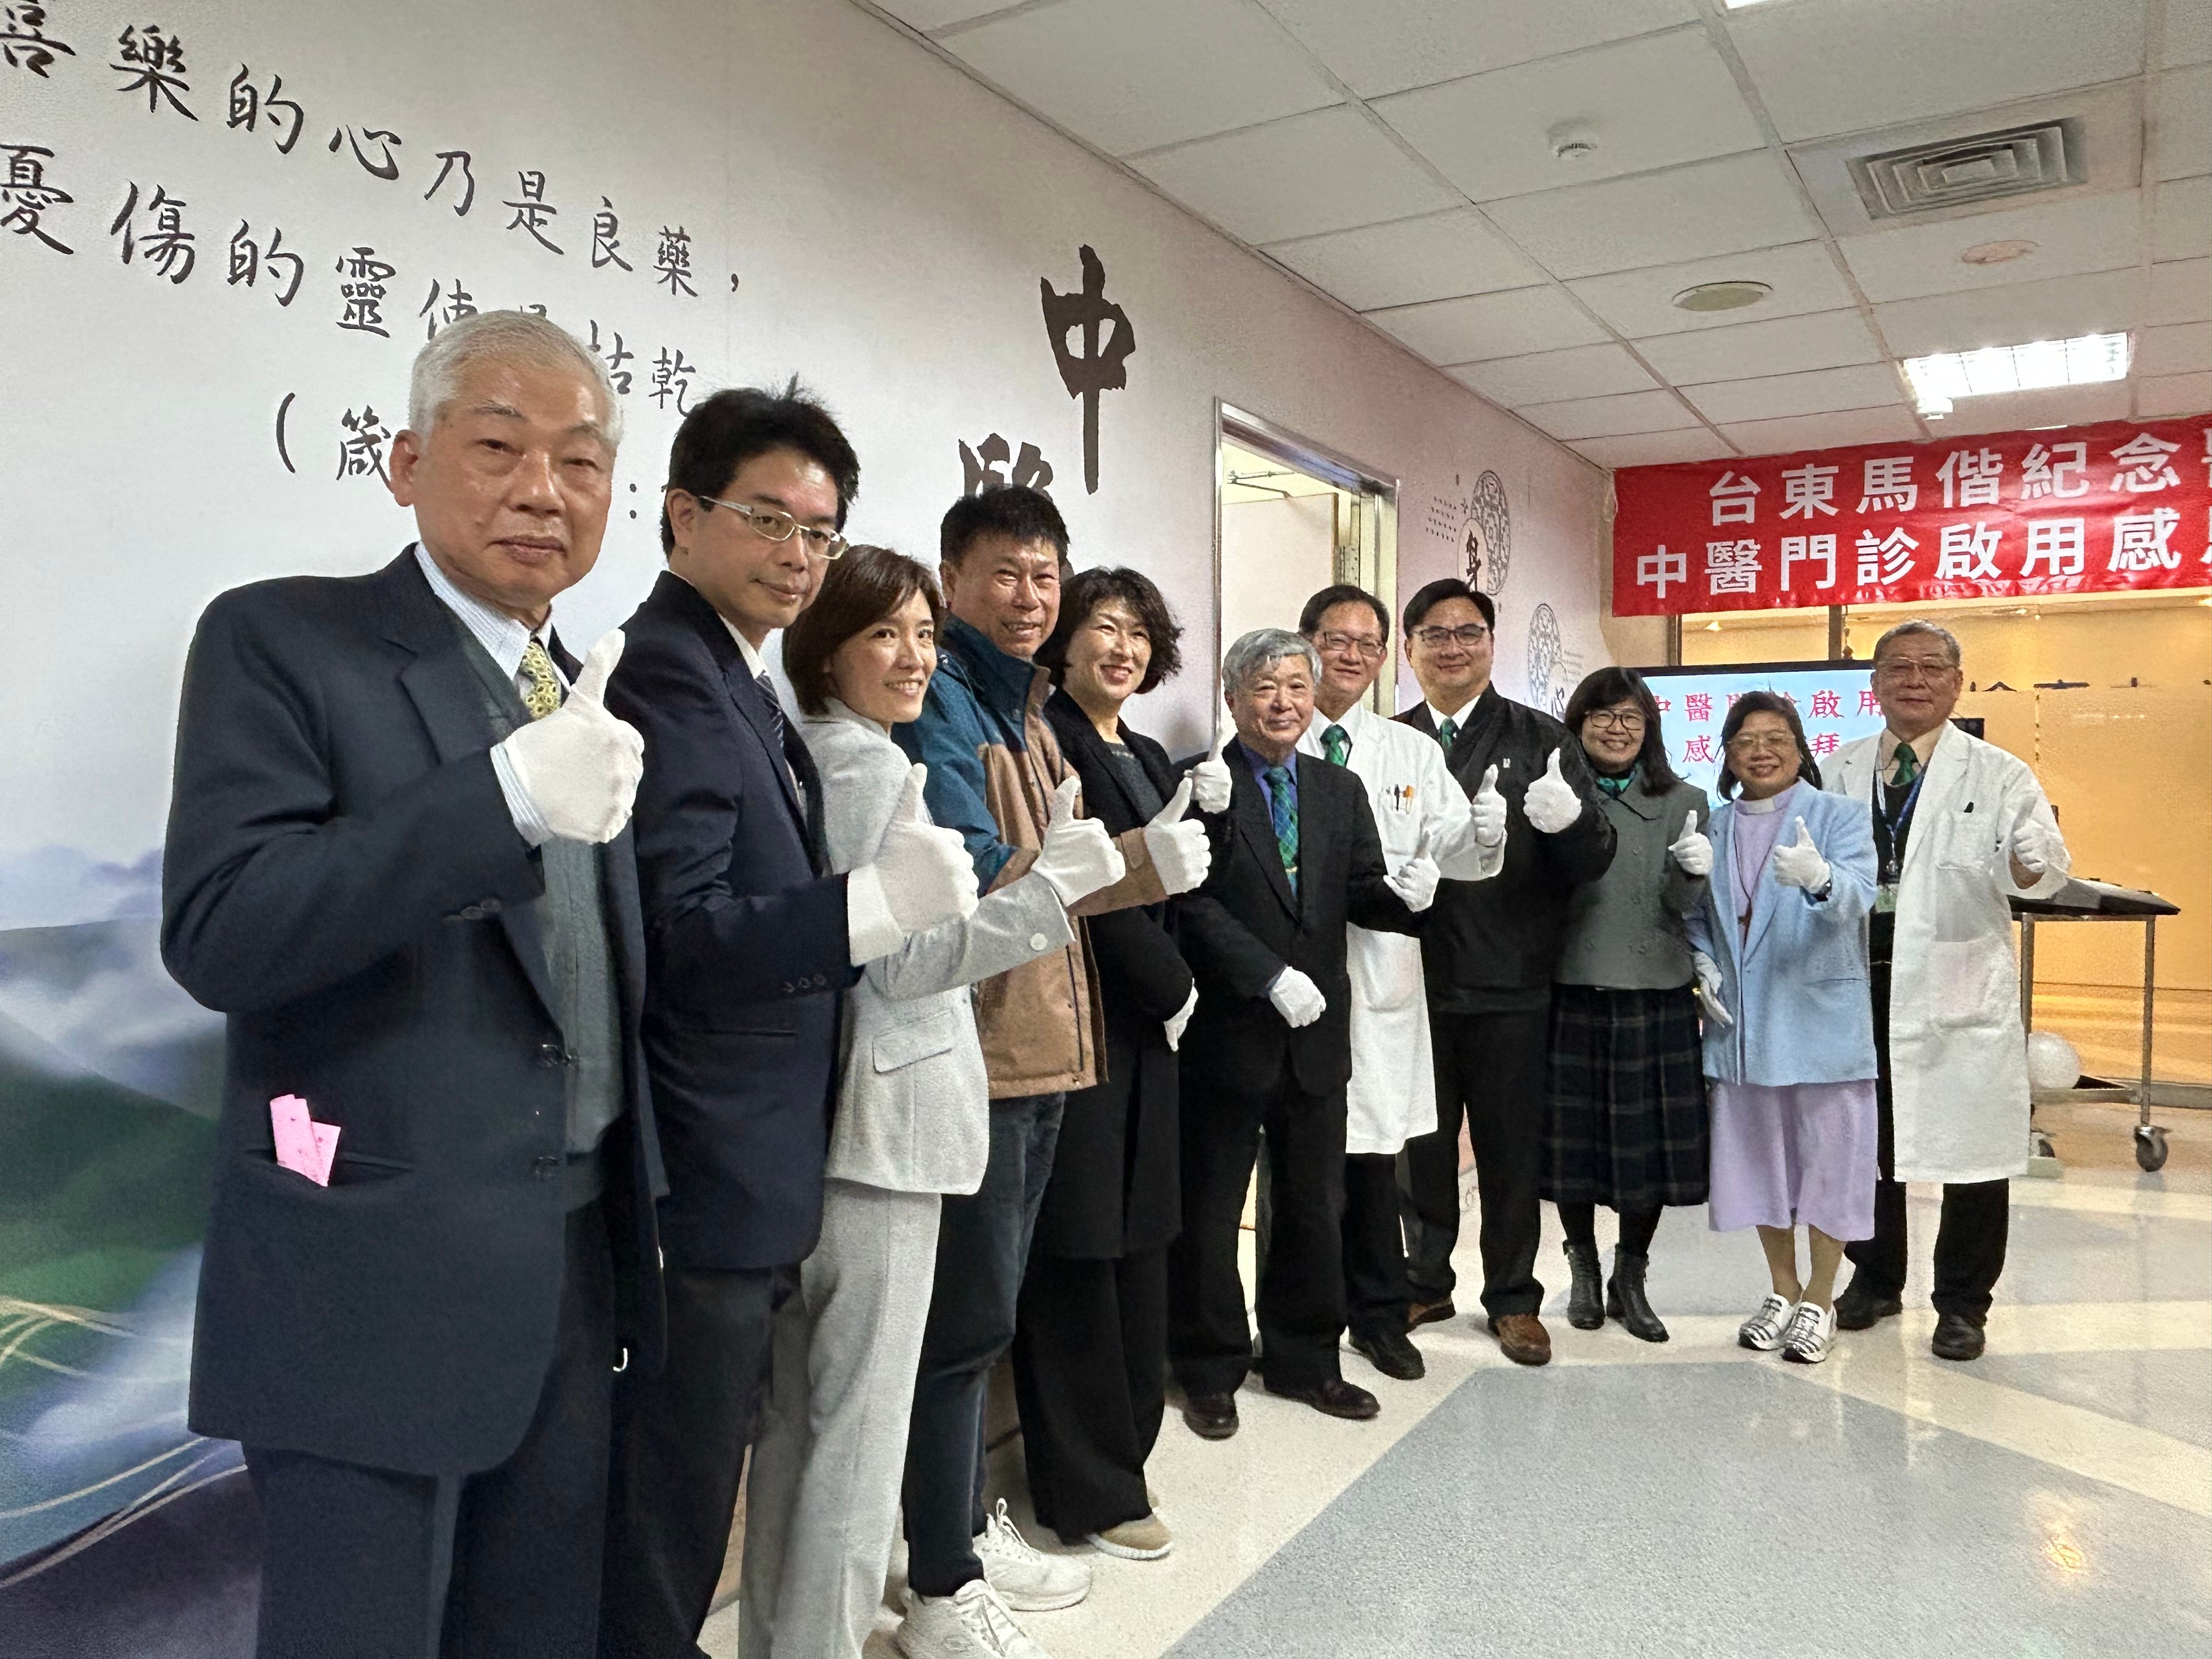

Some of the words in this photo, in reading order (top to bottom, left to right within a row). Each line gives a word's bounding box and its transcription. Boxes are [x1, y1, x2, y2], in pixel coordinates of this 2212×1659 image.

[1708, 428, 2212, 526] 台東馬偕紀念
[1637, 506, 2212, 599] 中醫門診啟用感
